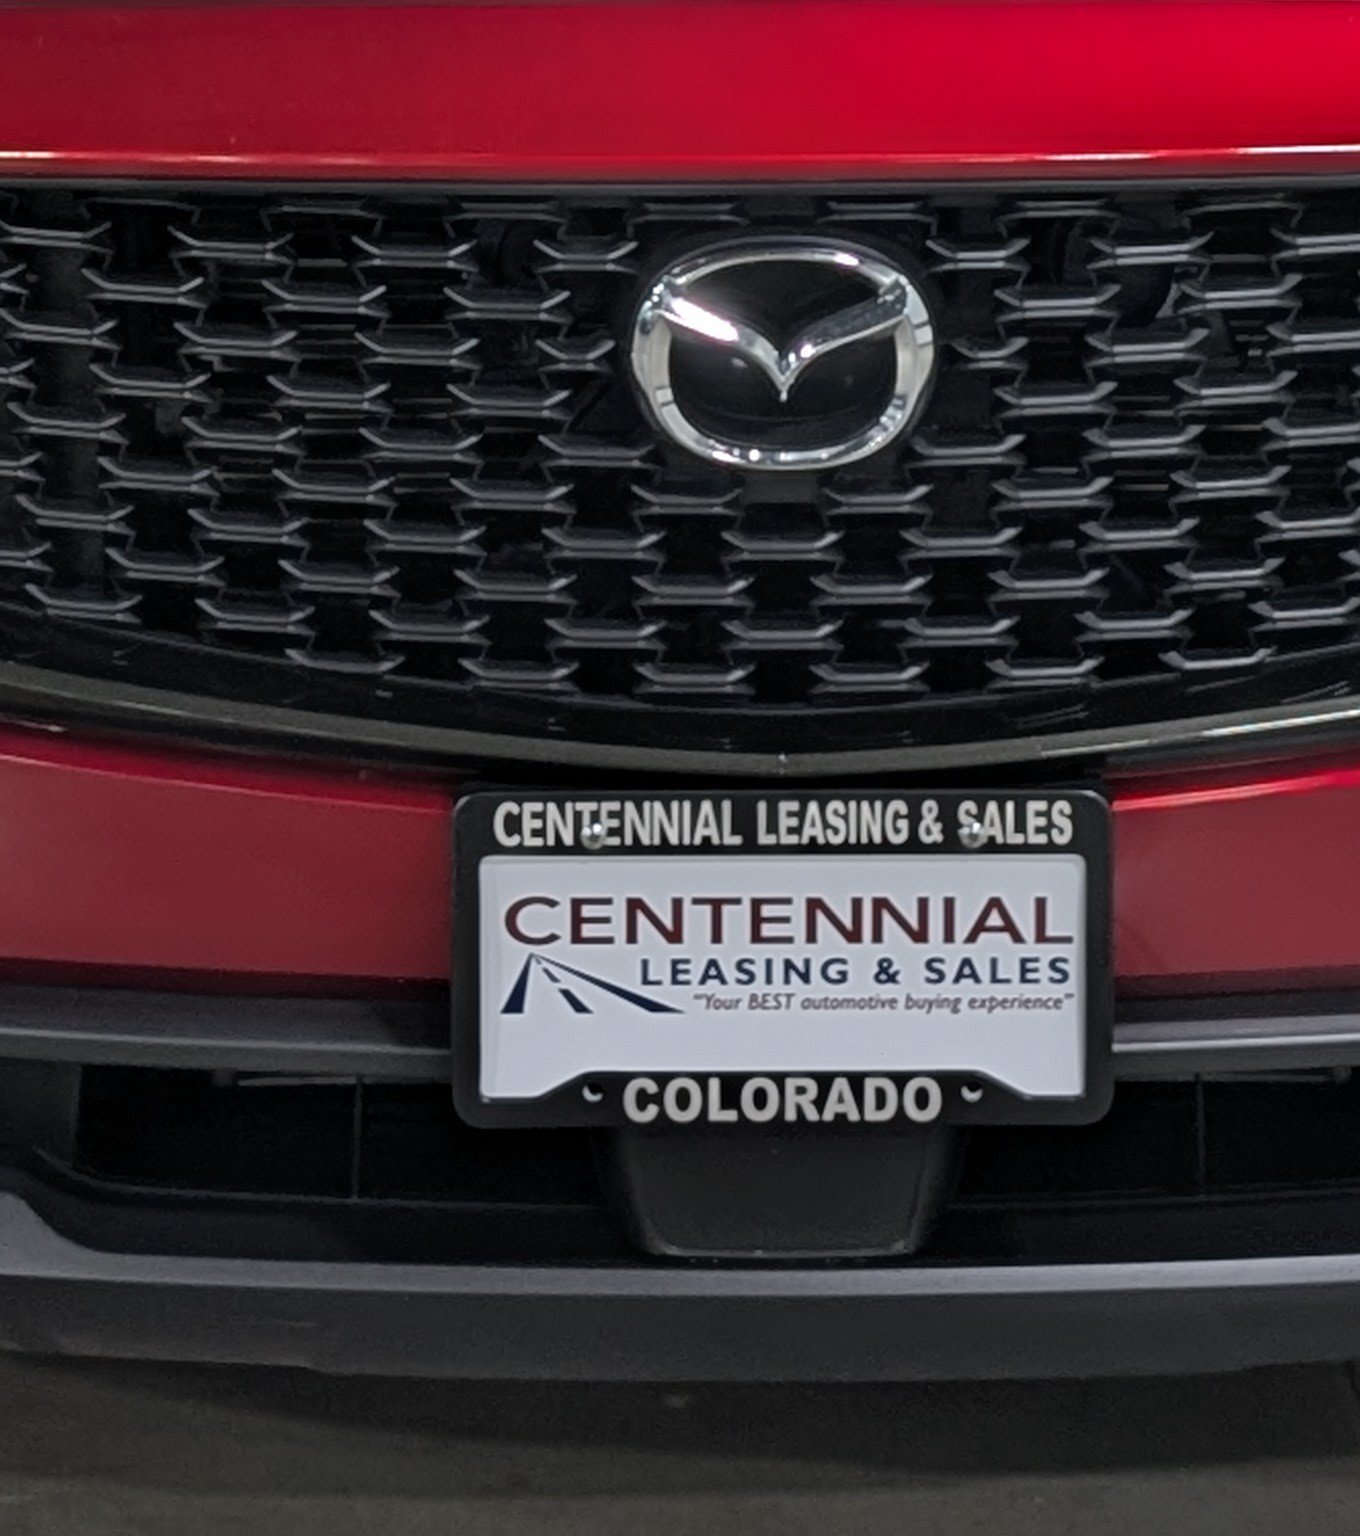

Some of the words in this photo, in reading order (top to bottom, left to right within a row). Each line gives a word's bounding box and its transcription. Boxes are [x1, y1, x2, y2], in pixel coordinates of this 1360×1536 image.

[493, 799, 743, 847] CENTENNIAL
[756, 799, 909, 846] LEASING
[917, 799, 944, 845] &
[956, 799, 1074, 846] SALES
[504, 896, 1074, 946] CENTENNIAL
[641, 957, 850, 986] LEASING
[873, 957, 901, 985] &
[924, 956, 1071, 985] SALES
[747, 993, 795, 1011] BEST
[800, 995, 899, 1011] automotive
[904, 993, 963, 1015] buying
[622, 1076, 943, 1124] COLORADO
